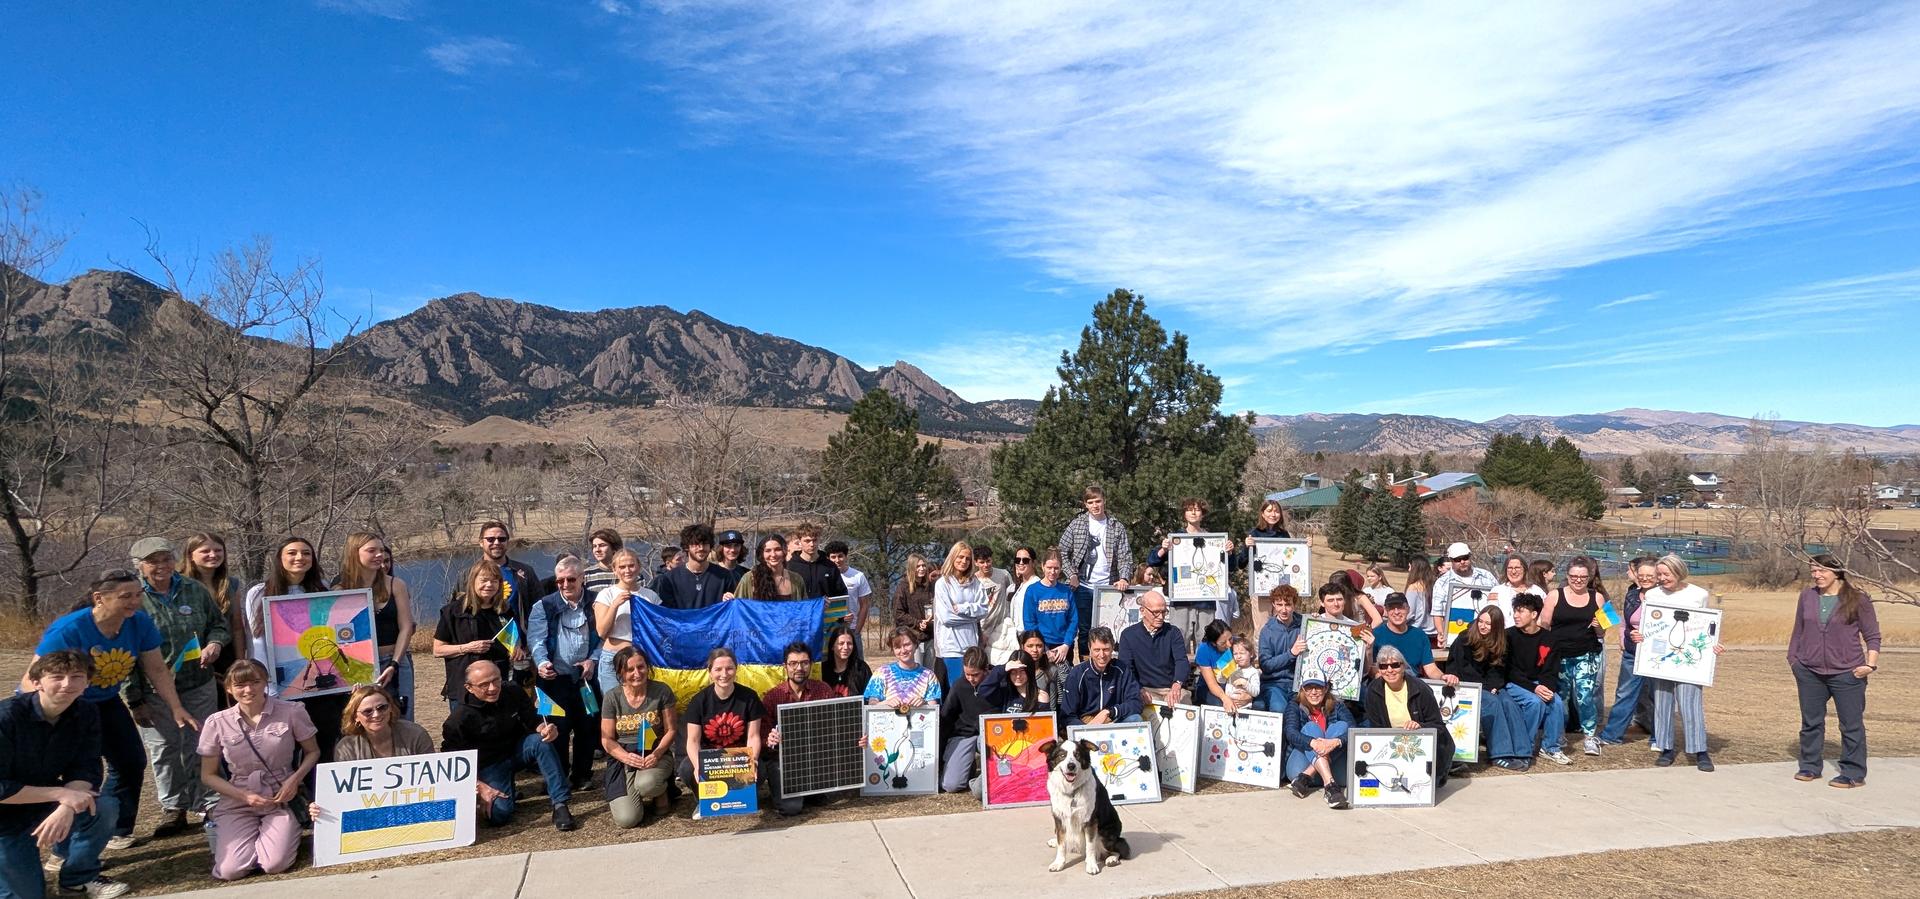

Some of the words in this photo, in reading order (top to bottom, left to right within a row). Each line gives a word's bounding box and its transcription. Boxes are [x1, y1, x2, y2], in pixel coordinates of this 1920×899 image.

[331, 766, 373, 793] WE
[383, 756, 471, 790] STAND
[361, 786, 435, 808] WITH
